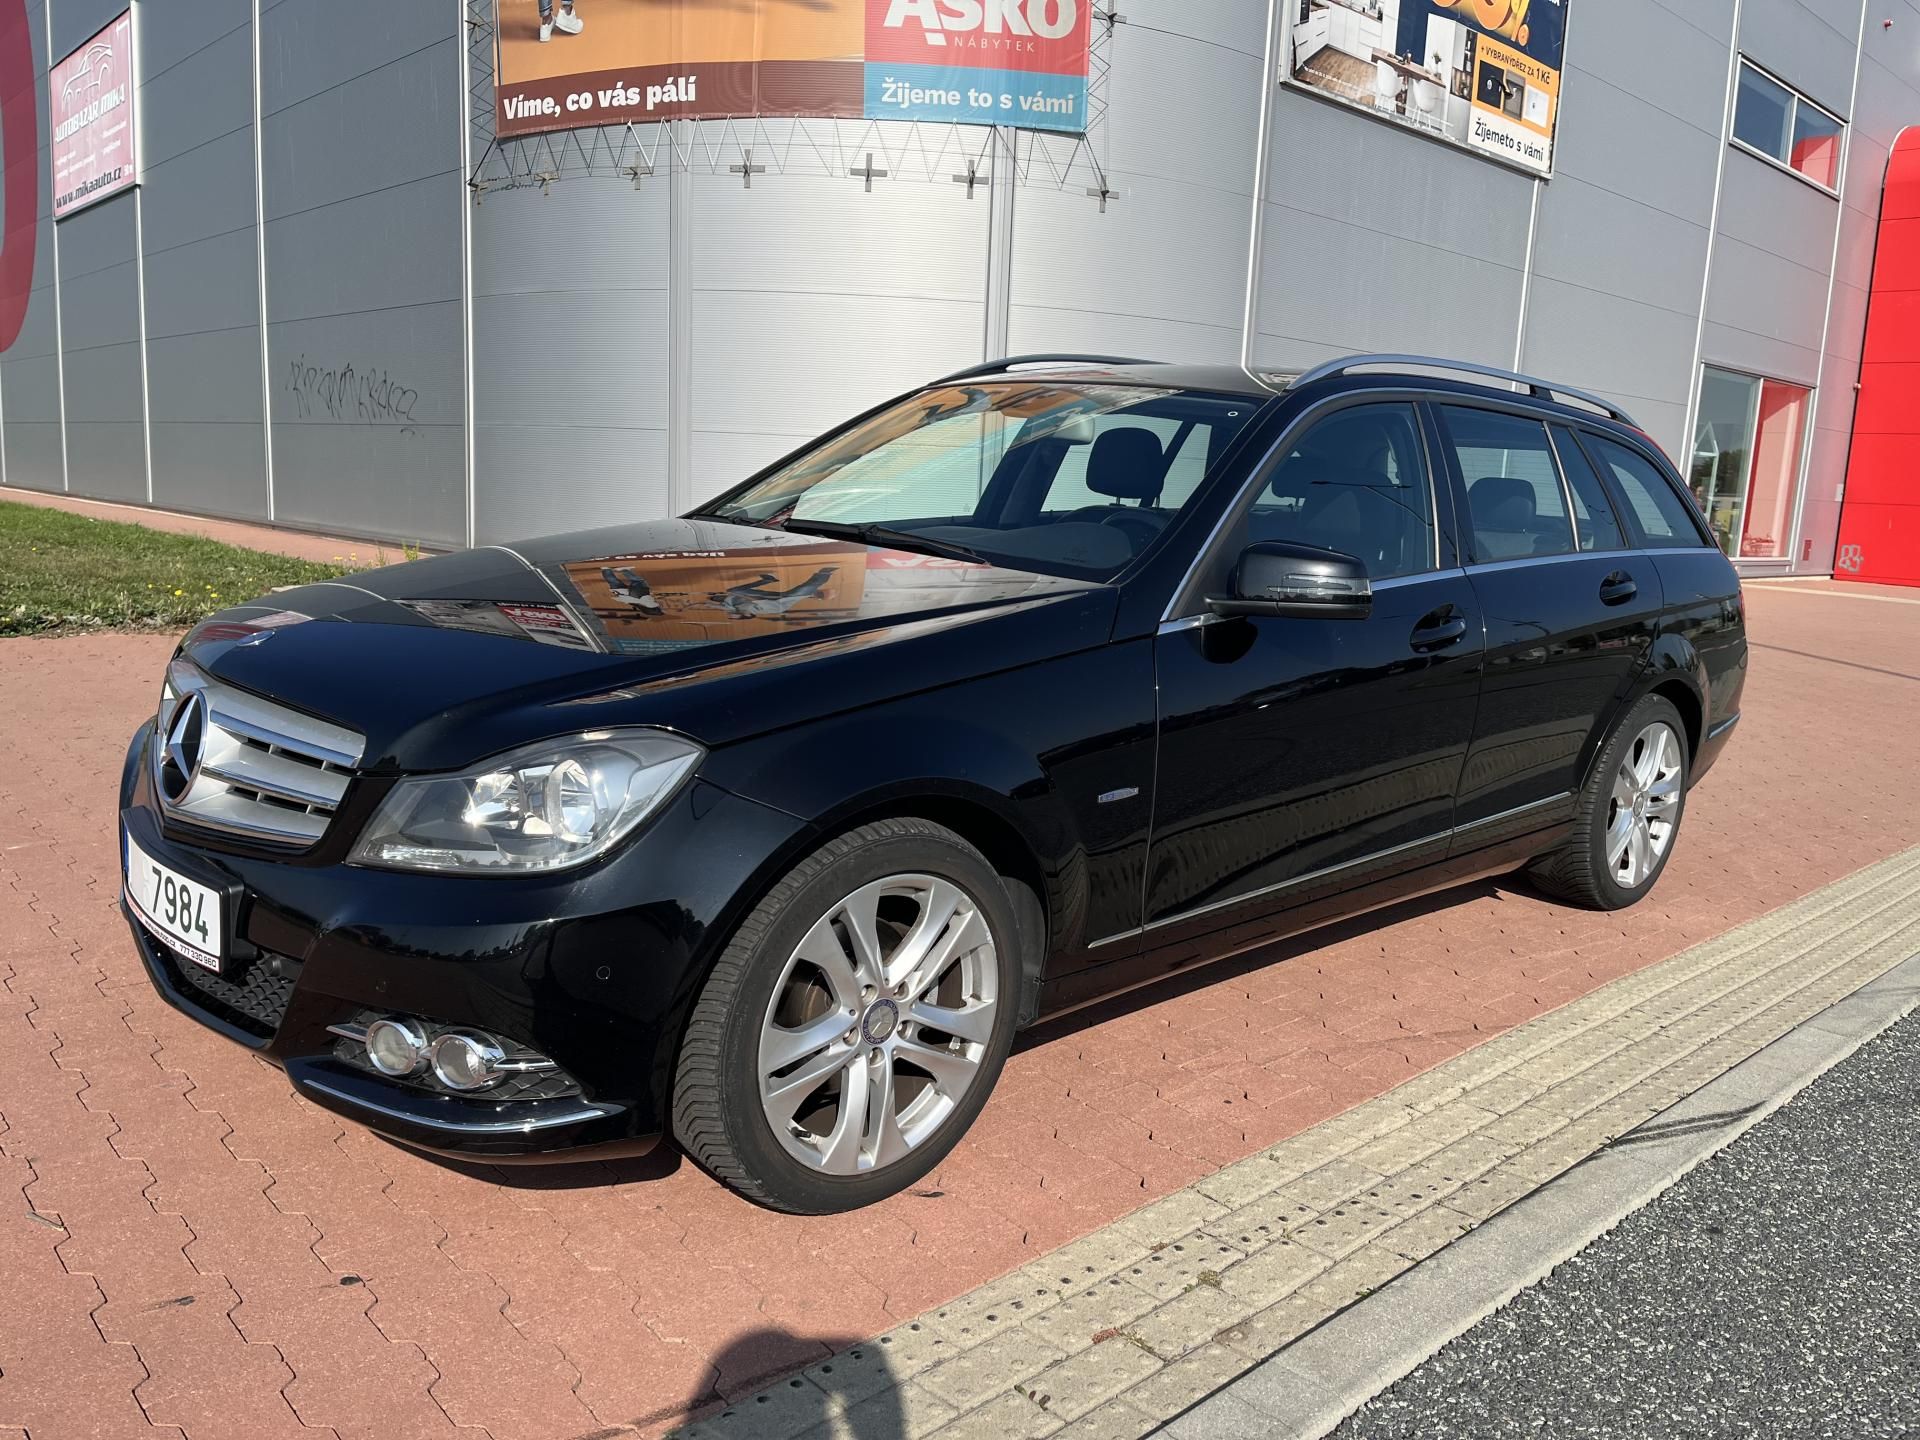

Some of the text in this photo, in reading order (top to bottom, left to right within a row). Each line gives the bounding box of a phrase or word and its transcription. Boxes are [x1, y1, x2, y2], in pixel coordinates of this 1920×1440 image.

[954, 35, 1035, 53] NÁBYTEK
[881, 77, 1074, 114] Žijeme to s vámi
[1528, 66, 1535, 78] ZA
[1536, 67, 1540, 80] 1
[1541, 70, 1551, 85] Kč
[55, 101, 98, 144] AUTOBAZAR
[100, 83, 126, 117] MIKA
[503, 75, 696, 120] Víme, co vás pálí
[1516, 140, 1522, 151] s
[1523, 141, 1544, 162] vámi
[55, 166, 121, 209] www.mikaauto.cz
[152, 865, 209, 944] 7984
